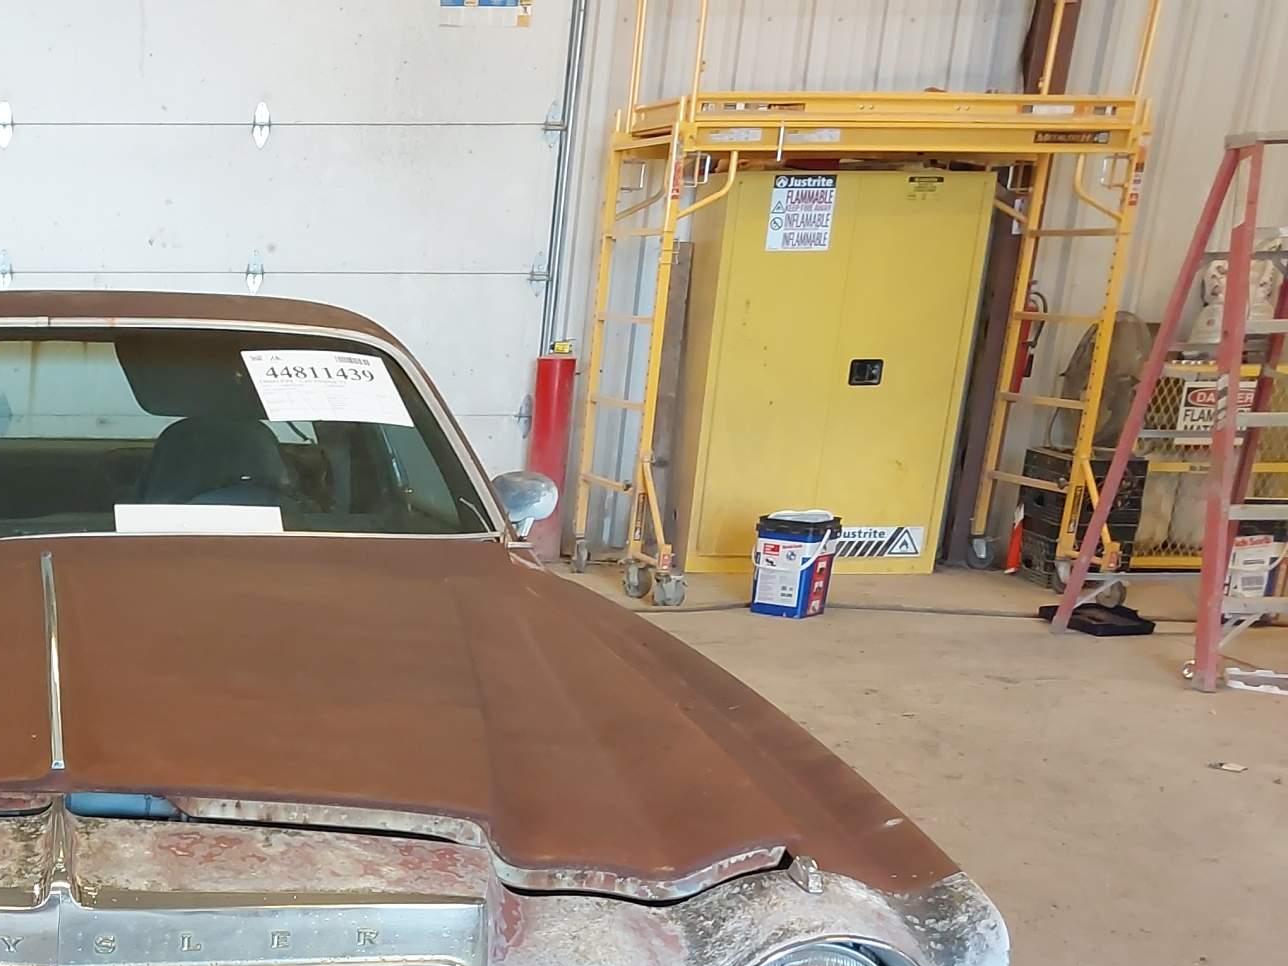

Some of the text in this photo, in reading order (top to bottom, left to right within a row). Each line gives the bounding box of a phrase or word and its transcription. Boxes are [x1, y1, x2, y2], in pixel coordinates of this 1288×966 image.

[788, 176, 834, 187] Justrite
[786, 189, 834, 204] FLAMMABLE
[266, 366, 374, 382] 44811439
[1196, 392, 1254, 403] DAER
